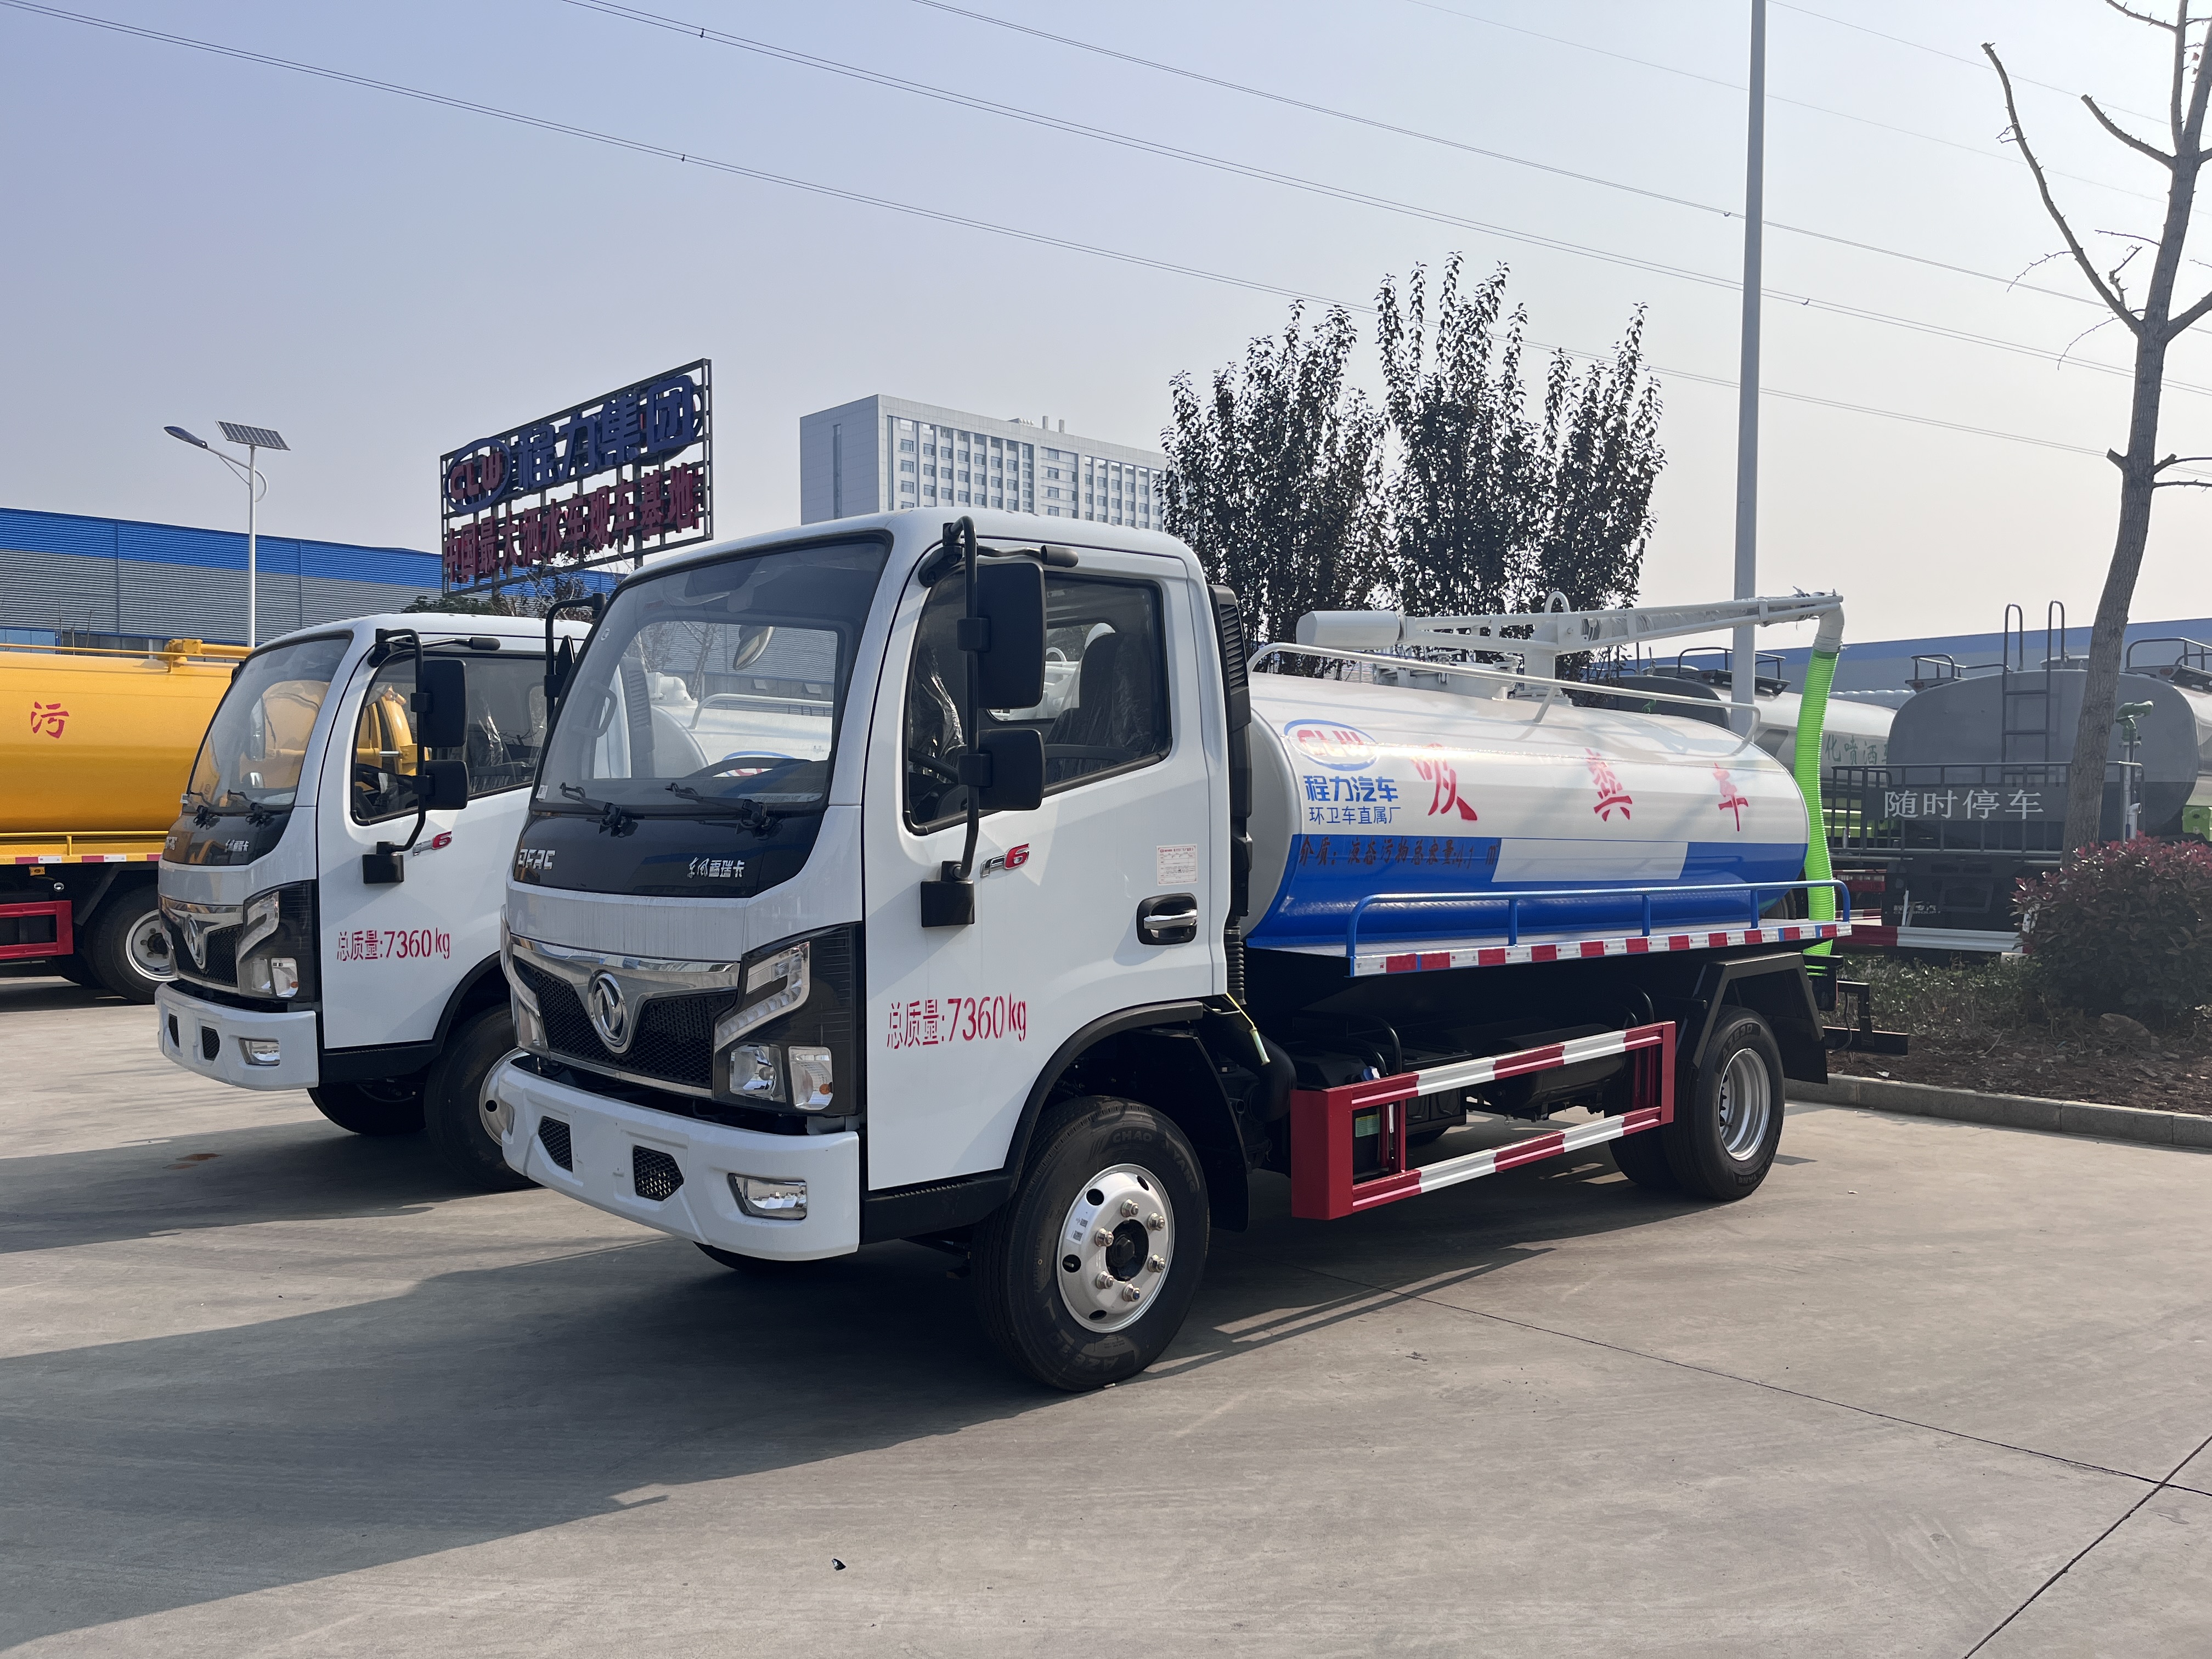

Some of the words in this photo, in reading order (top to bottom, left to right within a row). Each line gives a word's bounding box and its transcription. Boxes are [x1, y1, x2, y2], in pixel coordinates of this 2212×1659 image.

[517, 375, 695, 491] 程力集团
[450, 452, 503, 500] CLW
[30, 701, 70, 739] 污
[1302, 775, 1398, 803] 程力汽车
[1884, 789, 2044, 820] 随时停车
[1308, 806, 1401, 825] 环卫车直属厂
[1112, 1130, 1153, 1144] CHAO
